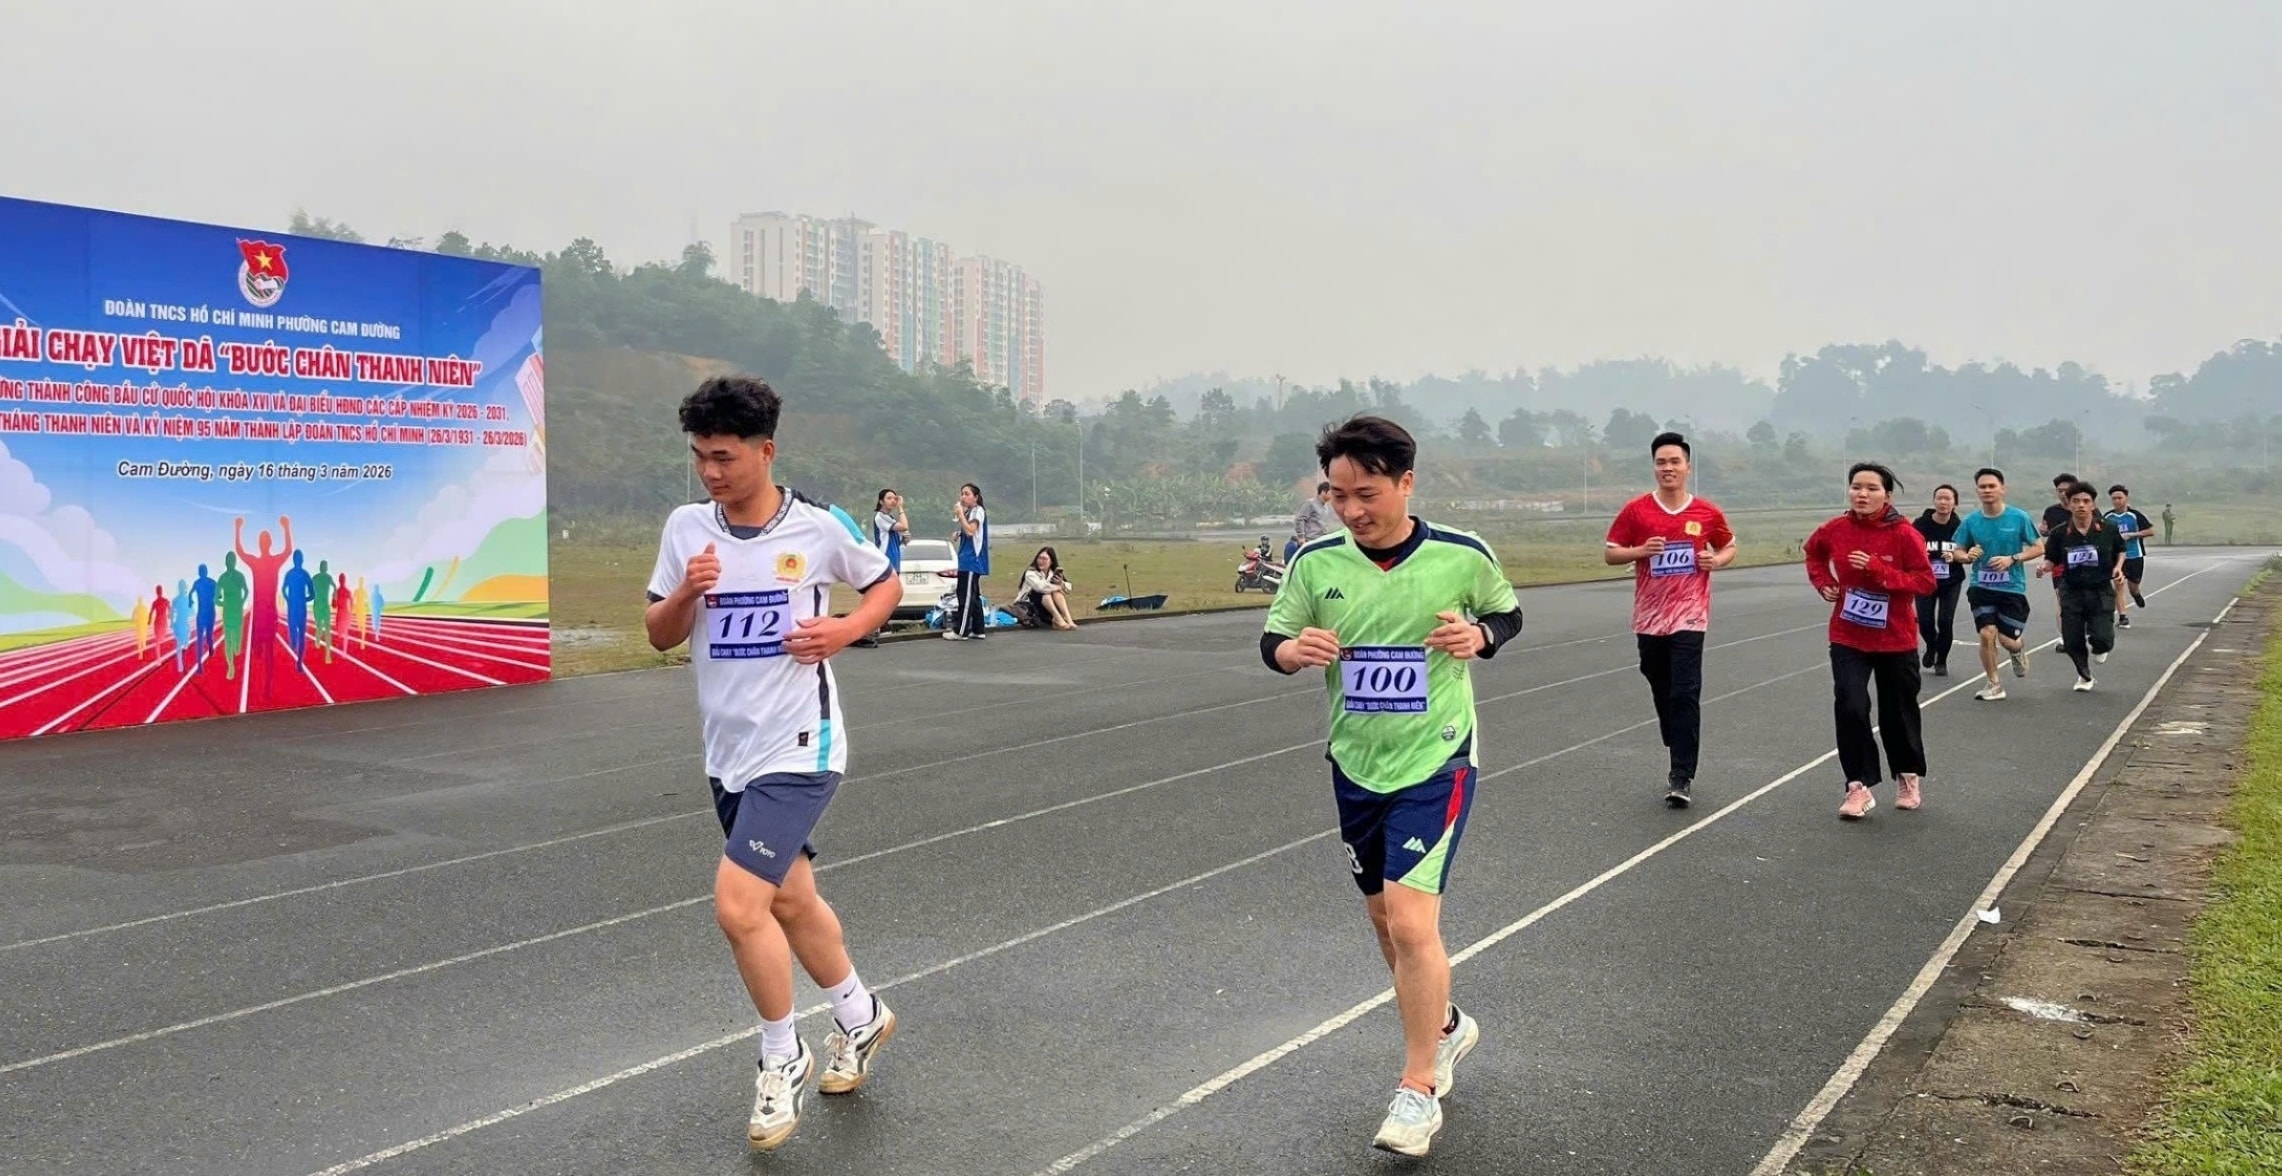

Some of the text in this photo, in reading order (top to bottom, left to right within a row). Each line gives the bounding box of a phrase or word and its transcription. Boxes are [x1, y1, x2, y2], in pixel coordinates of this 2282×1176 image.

[105, 298, 401, 340] ĐOÀN TNCS HỒ CHÍ MINH PHƯỜNG CAM ĐƯỜNG
[0, 319, 40, 360] IẢI
[47, 330, 116, 369] CHẠY
[121, 332, 177, 372] VIỆT
[182, 337, 215, 371] DÃ
[294, 346, 351, 379] CHÂN
[356, 353, 423, 383] THANH
[27, 378, 72, 402] THÀNH
[75, 381, 110, 403] CÔNG
[113, 380, 139, 405] BẦU
[142, 382, 160, 406] CỬ
[162, 383, 194, 408] QUỐC
[196, 387, 216, 413] HỘI
[219, 388, 250, 410] KHÓA
[252, 393, 270, 411] XVI
[272, 390, 287, 411] VÀ
[289, 395, 307, 415] ĐẠI
[310, 390, 334, 414] BIỂU
[336, 397, 364, 415] HĐND
[366, 396, 386, 415] CÁC
[388, 396, 407, 416] CẤP
[410, 398, 441, 420] NHIỆM
[456, 404, 478, 420] 2026
[0, 408, 40, 432] HÁNG
[44, 414, 87, 434] THANH
[91, 412, 122, 434] NIÊN
[125, 414, 141, 435] VÀ
[163, 415, 194, 440] NIỆM
[197, 420, 211, 437] 95
[214, 417, 241, 438] NĂM
[243, 418, 279, 439] THÀNH
[282, 419, 302, 443] LẬP
[305, 420, 334, 441] ĐOÀN
[336, 424, 362, 442] TNCS
[380, 422, 397, 443] CHÍ
[400, 426, 425, 443] MINH
[428, 427, 474, 445] (26/3/1931
[483, 430, 528, 447] 26/3/2026)
[118, 460, 392, 481] Cam Đường, ngày 16 tháng 3 năm 2026
[1657, 551, 1690, 567] 106
[1850, 599, 1883, 617] 129
[719, 610, 780, 639] 112
[1353, 666, 1416, 693] 100
